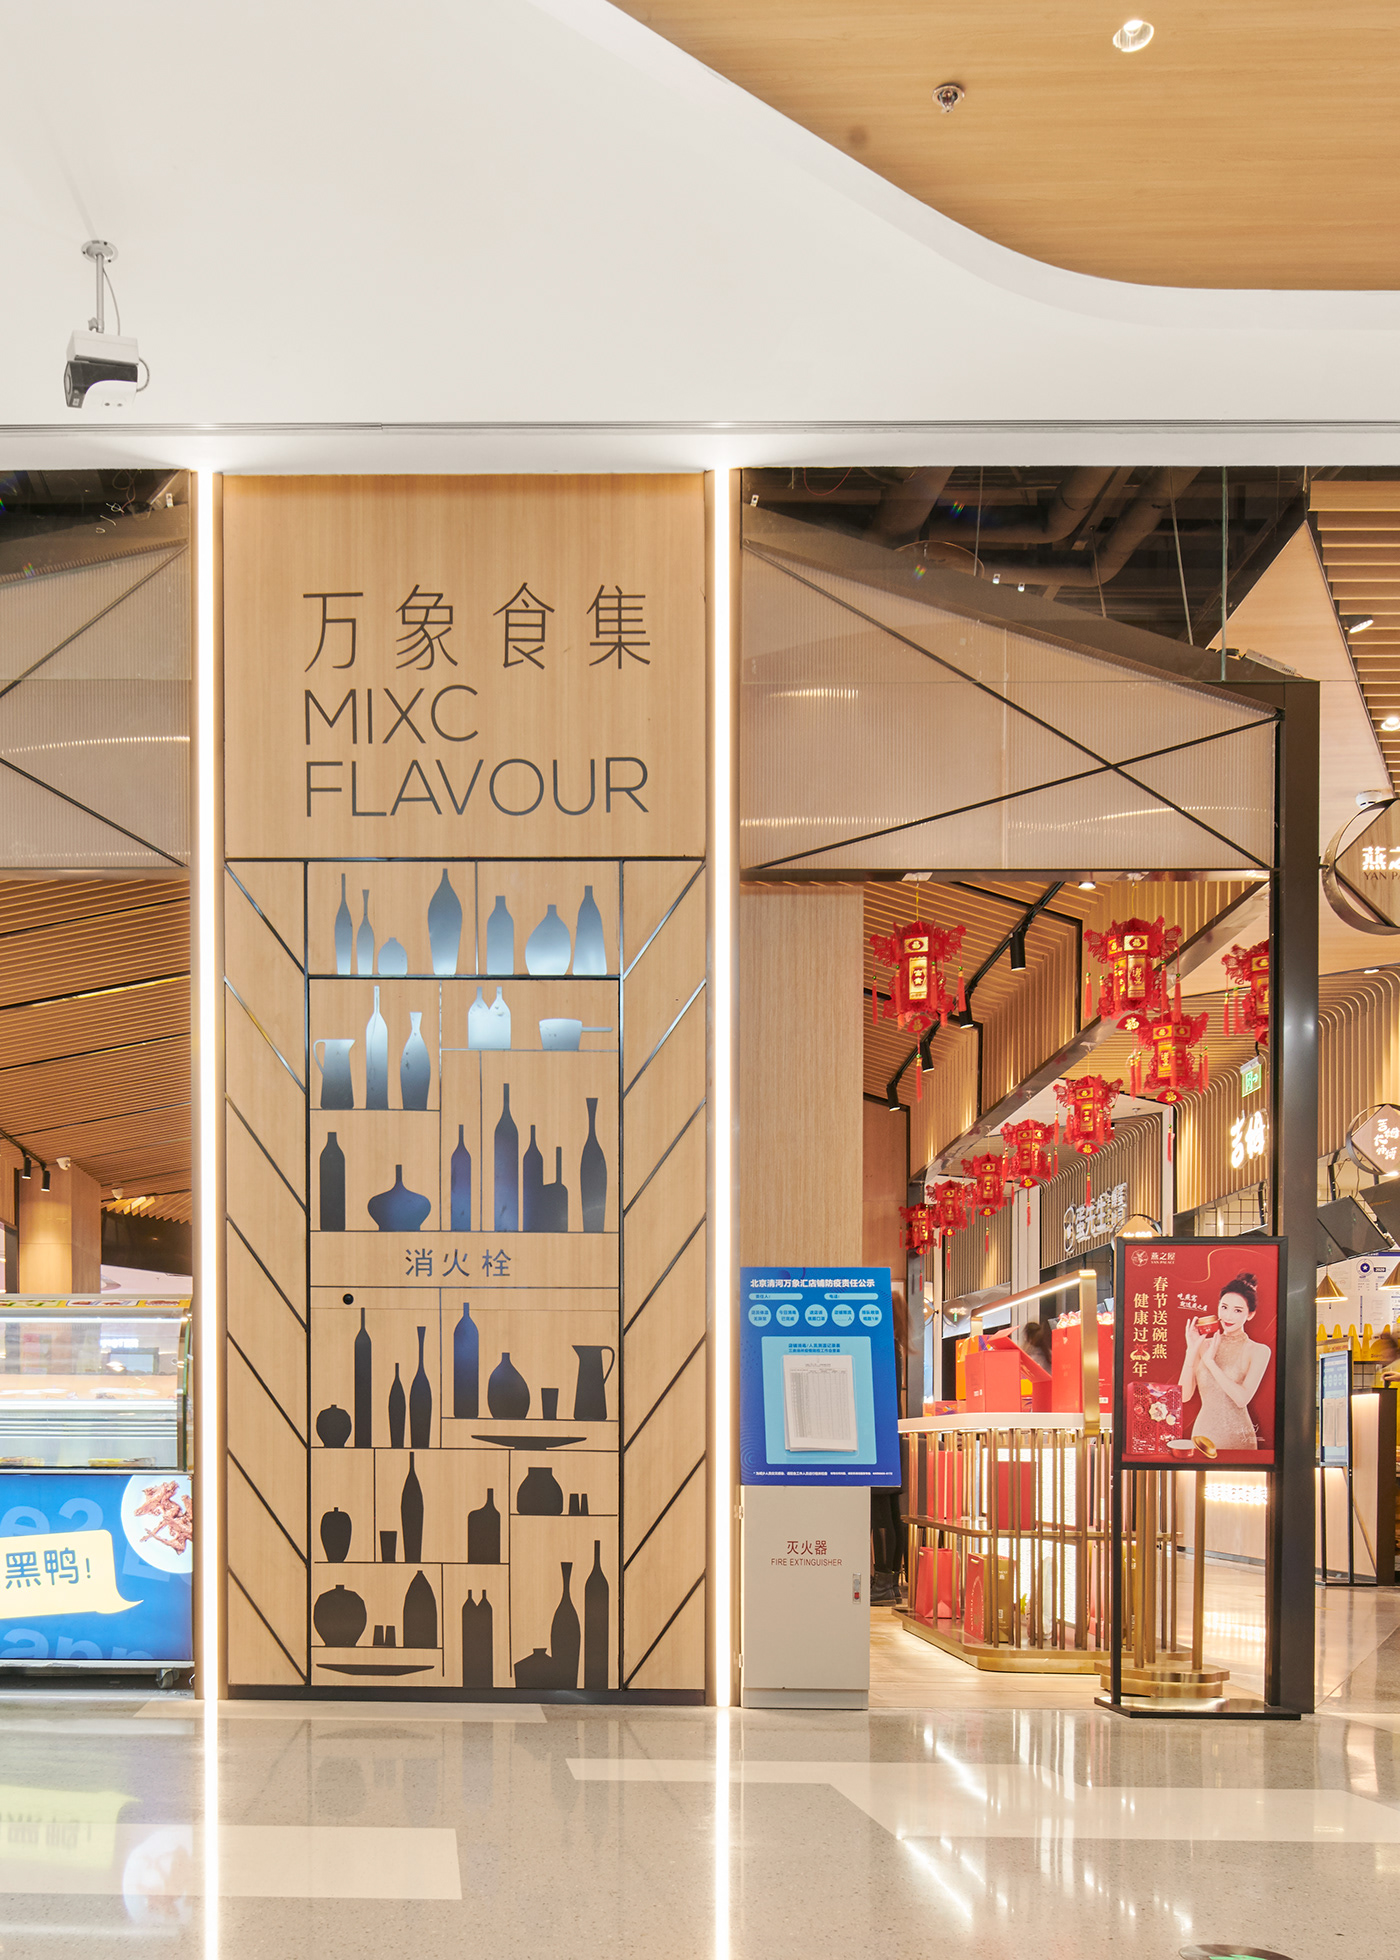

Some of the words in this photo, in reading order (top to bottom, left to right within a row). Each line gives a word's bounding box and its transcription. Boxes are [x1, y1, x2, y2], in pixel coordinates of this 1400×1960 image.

[303, 582, 651, 672] 万象食集
[305, 684, 479, 745] MIXC
[306, 757, 649, 817] FLAVOUR
[1363, 871, 1387, 880] YAN
[405, 1248, 511, 1278] 消火栓
[1152, 1276, 1168, 1360] 春节送碗燕
[770, 1558, 788, 1567] FIRE
[790, 1558, 843, 1567] EXTINGUISHER
[786, 1540, 828, 1555] 灭火器
